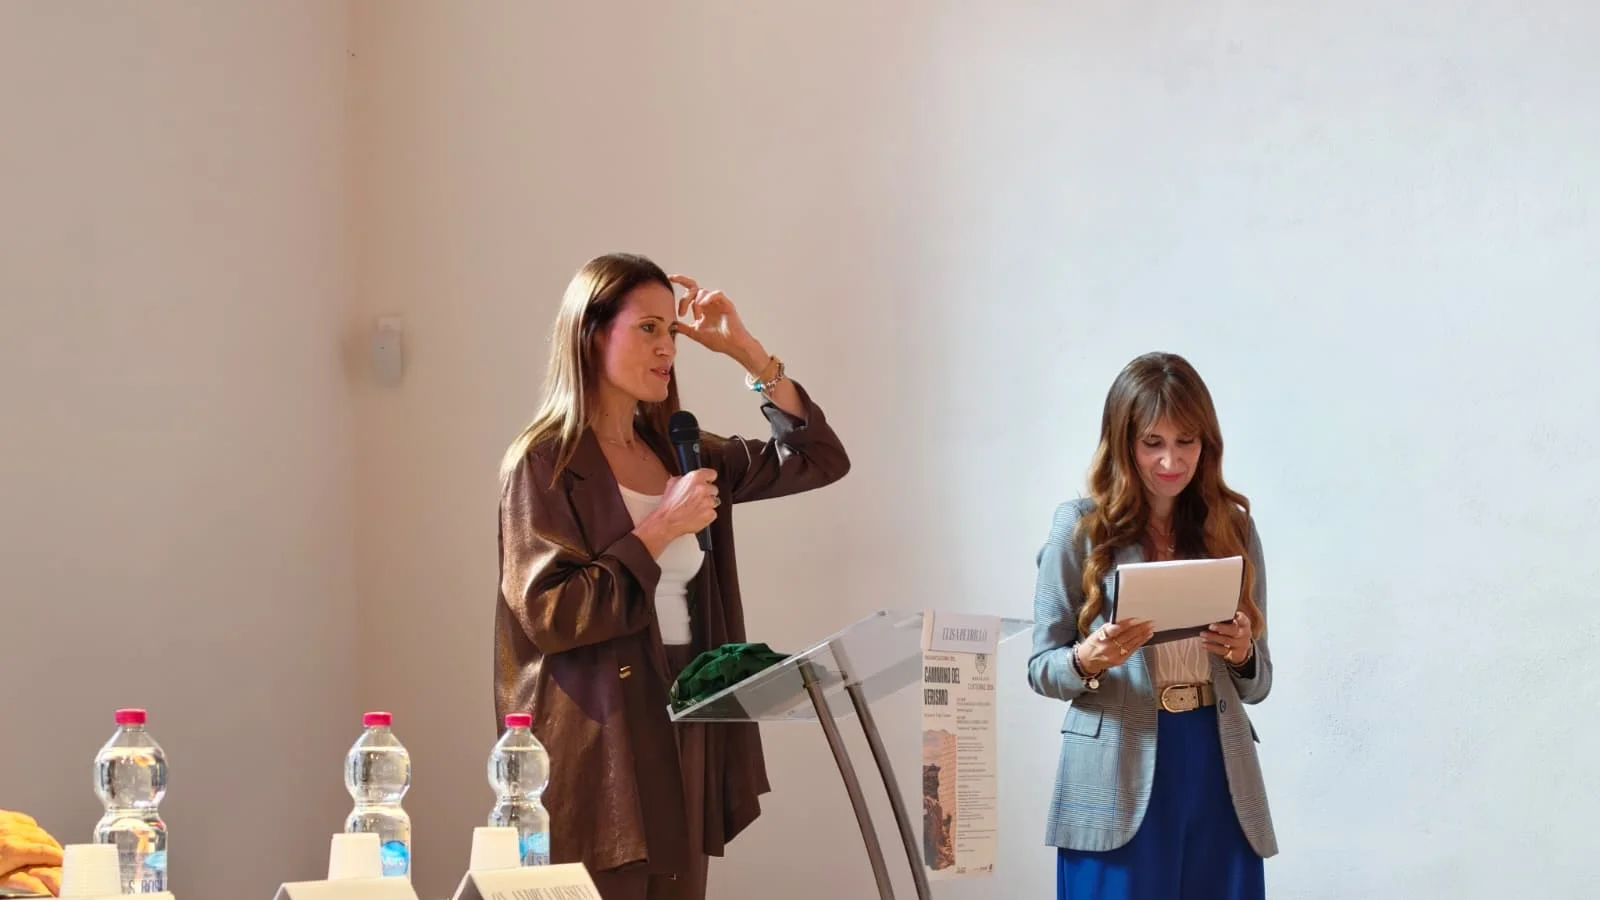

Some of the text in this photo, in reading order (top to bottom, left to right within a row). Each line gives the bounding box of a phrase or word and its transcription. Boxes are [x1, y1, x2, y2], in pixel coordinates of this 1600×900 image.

[924, 666, 961, 684] CAMMINO DEL
[924, 688, 948, 706] VERISMO
